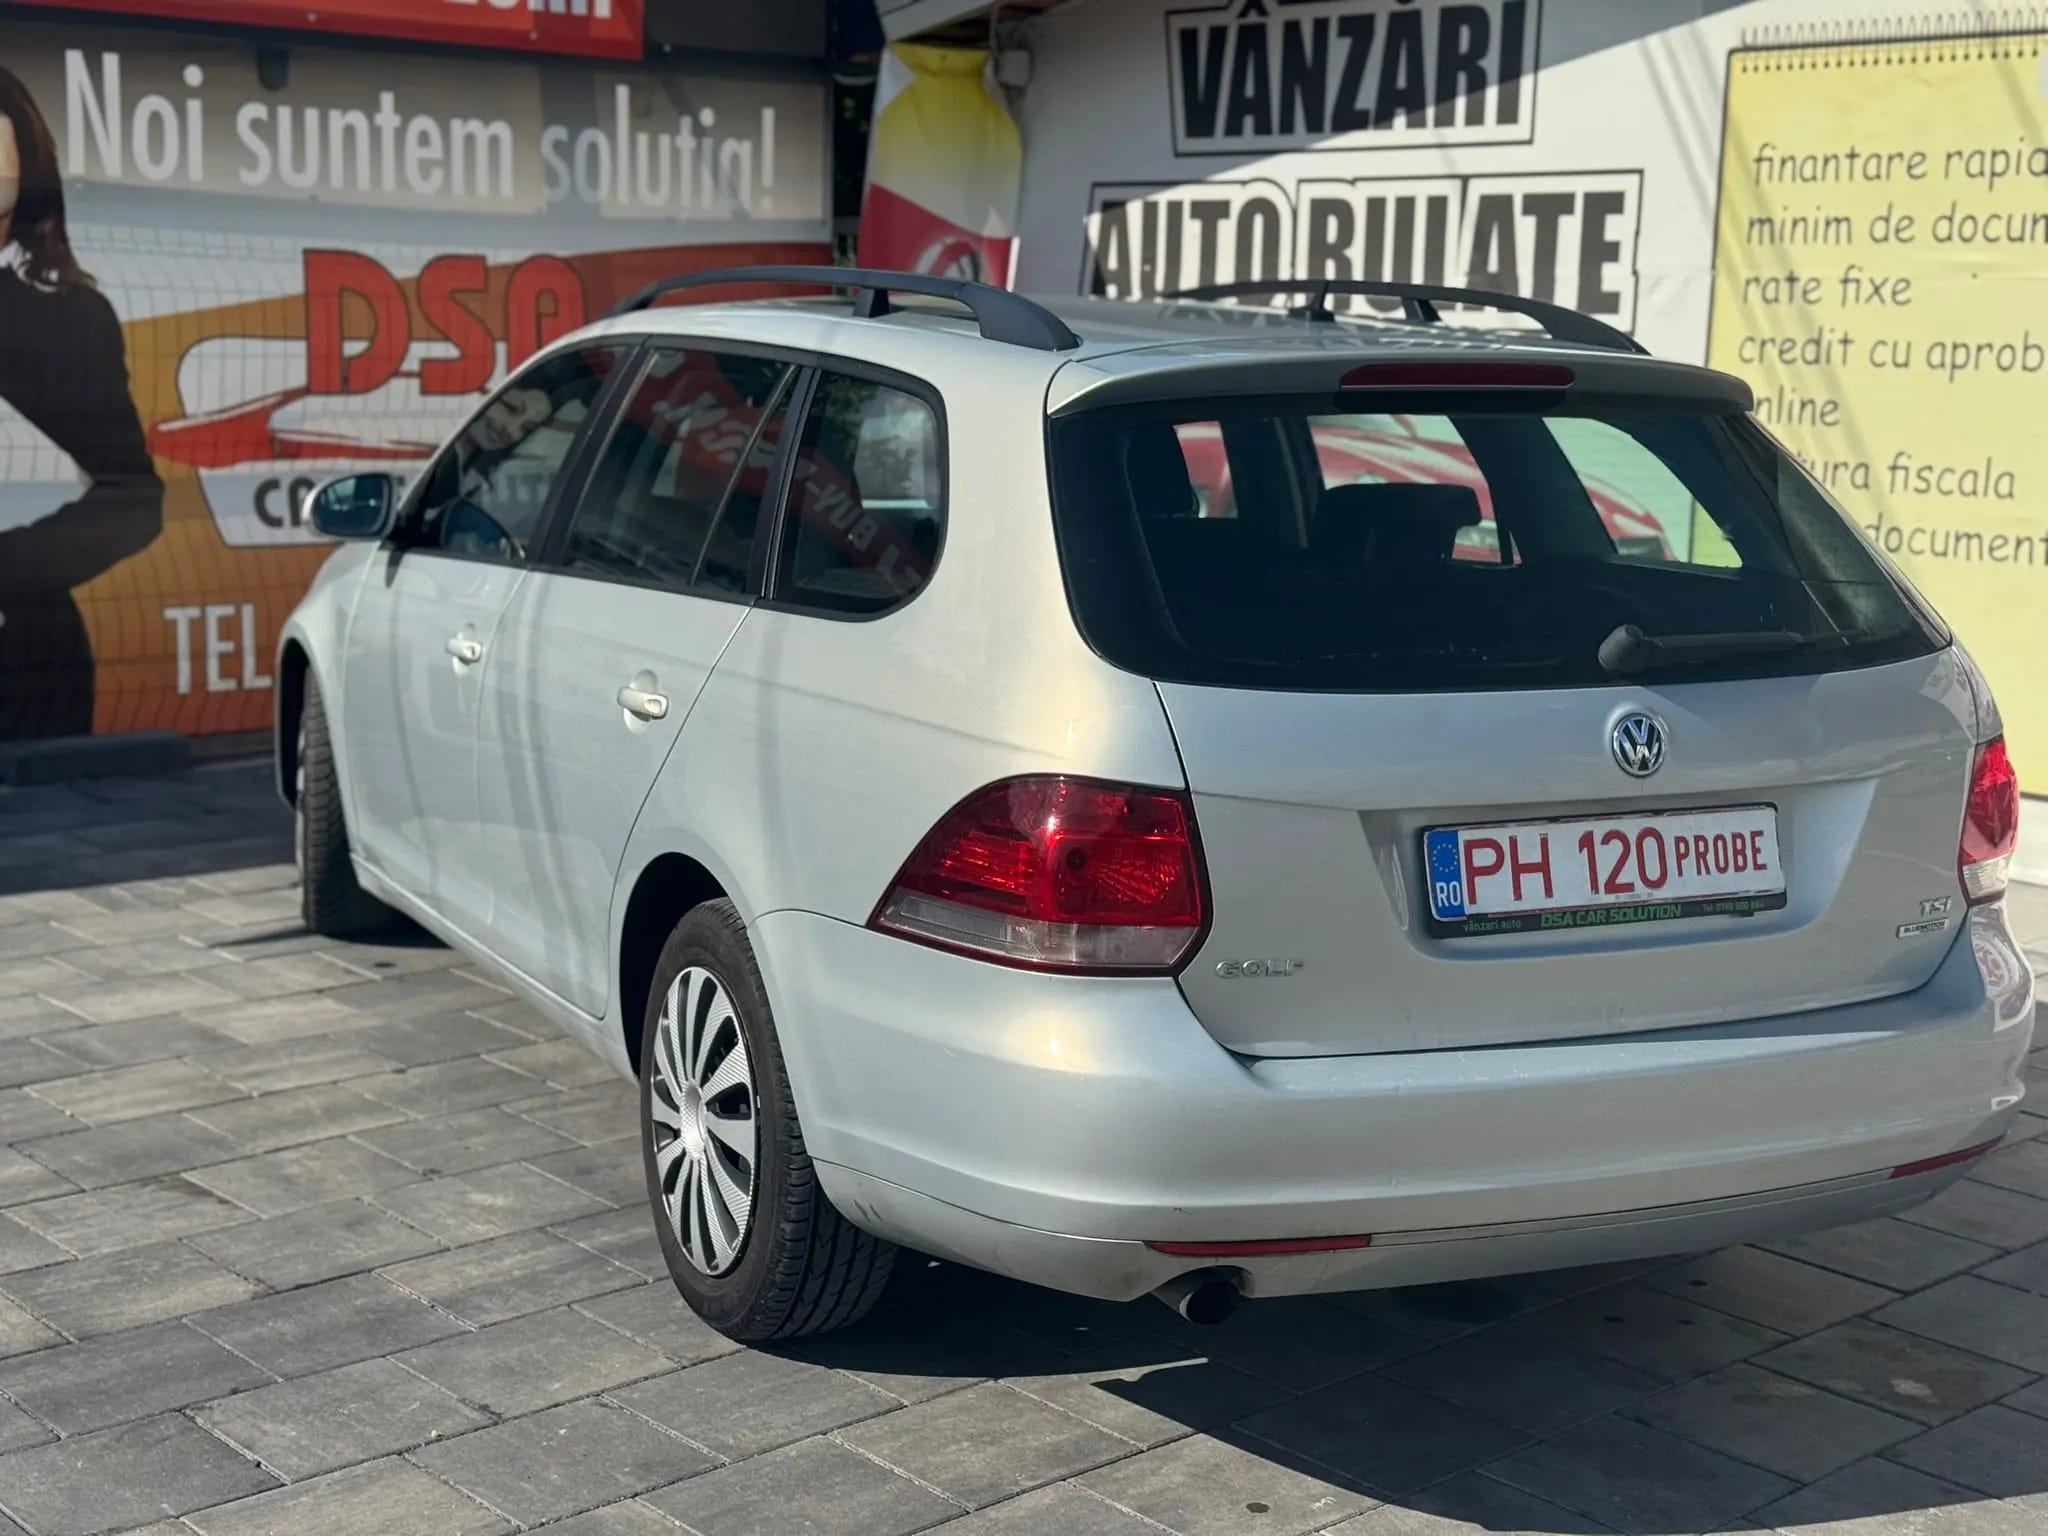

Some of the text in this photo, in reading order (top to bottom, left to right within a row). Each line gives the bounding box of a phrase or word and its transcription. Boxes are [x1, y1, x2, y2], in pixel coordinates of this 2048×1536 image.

[65, 48, 203, 181] Noi
[236, 91, 514, 198] suntem
[1753, 142, 1927, 187] finantare
[1747, 205, 1852, 245] minim
[1868, 202, 1915, 243] de
[1743, 264, 1912, 307] rate fixe
[302, 249, 587, 396] DSA
[1738, 327, 2045, 382] credit cu aprob
[1755, 385, 1841, 428] nline
[1887, 451, 2016, 500] fiscala
[163, 603, 273, 695] TEL
[1614, 715, 1663, 775] VW
[1436, 826, 1768, 908] RO PH 120 PROBE
[1541, 912, 1573, 928] DSA
[1576, 910, 1607, 925] CAR
[1609, 904, 1682, 922] SOLUTION
[1919, 896, 1952, 917] TSI
[1215, 959, 1304, 980] GOLF
